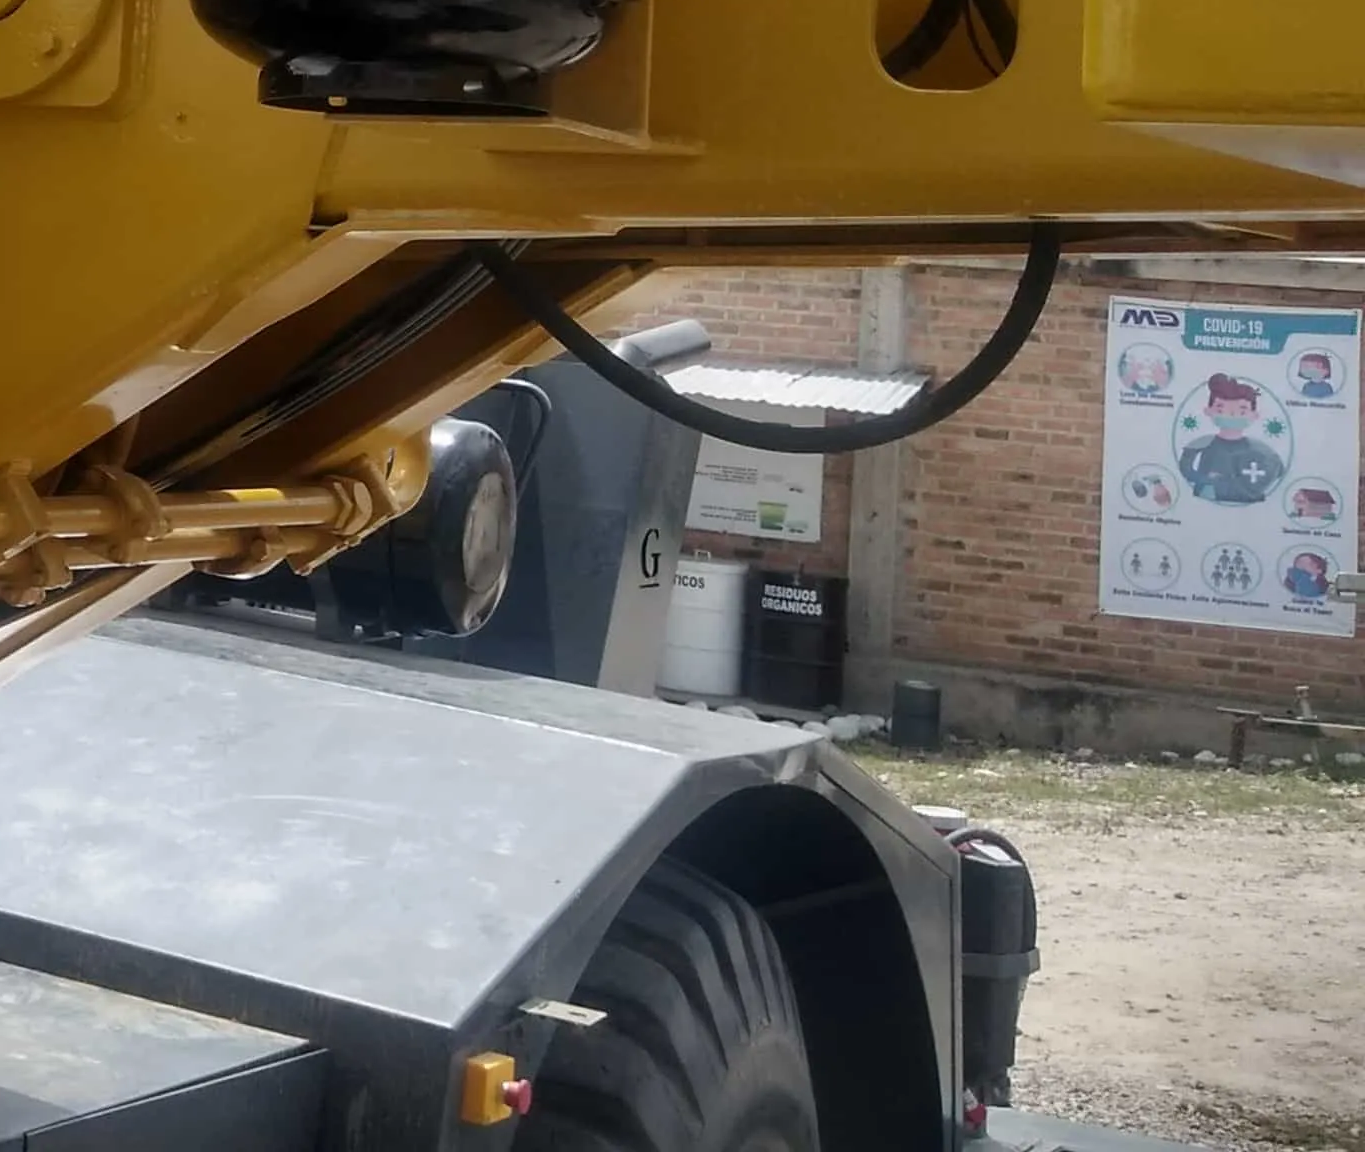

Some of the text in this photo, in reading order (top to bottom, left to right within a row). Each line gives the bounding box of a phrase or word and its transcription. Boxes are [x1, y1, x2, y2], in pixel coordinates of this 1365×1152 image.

[1203, 317, 1264, 335] COVID-19
[1194, 333, 1270, 350] PREVENCIÓN
[640, 528, 661, 579] G
[673, 574, 705, 589] TICOS
[764, 584, 816, 602] RESIDUOS
[761, 597, 822, 616] ORGANICOS
